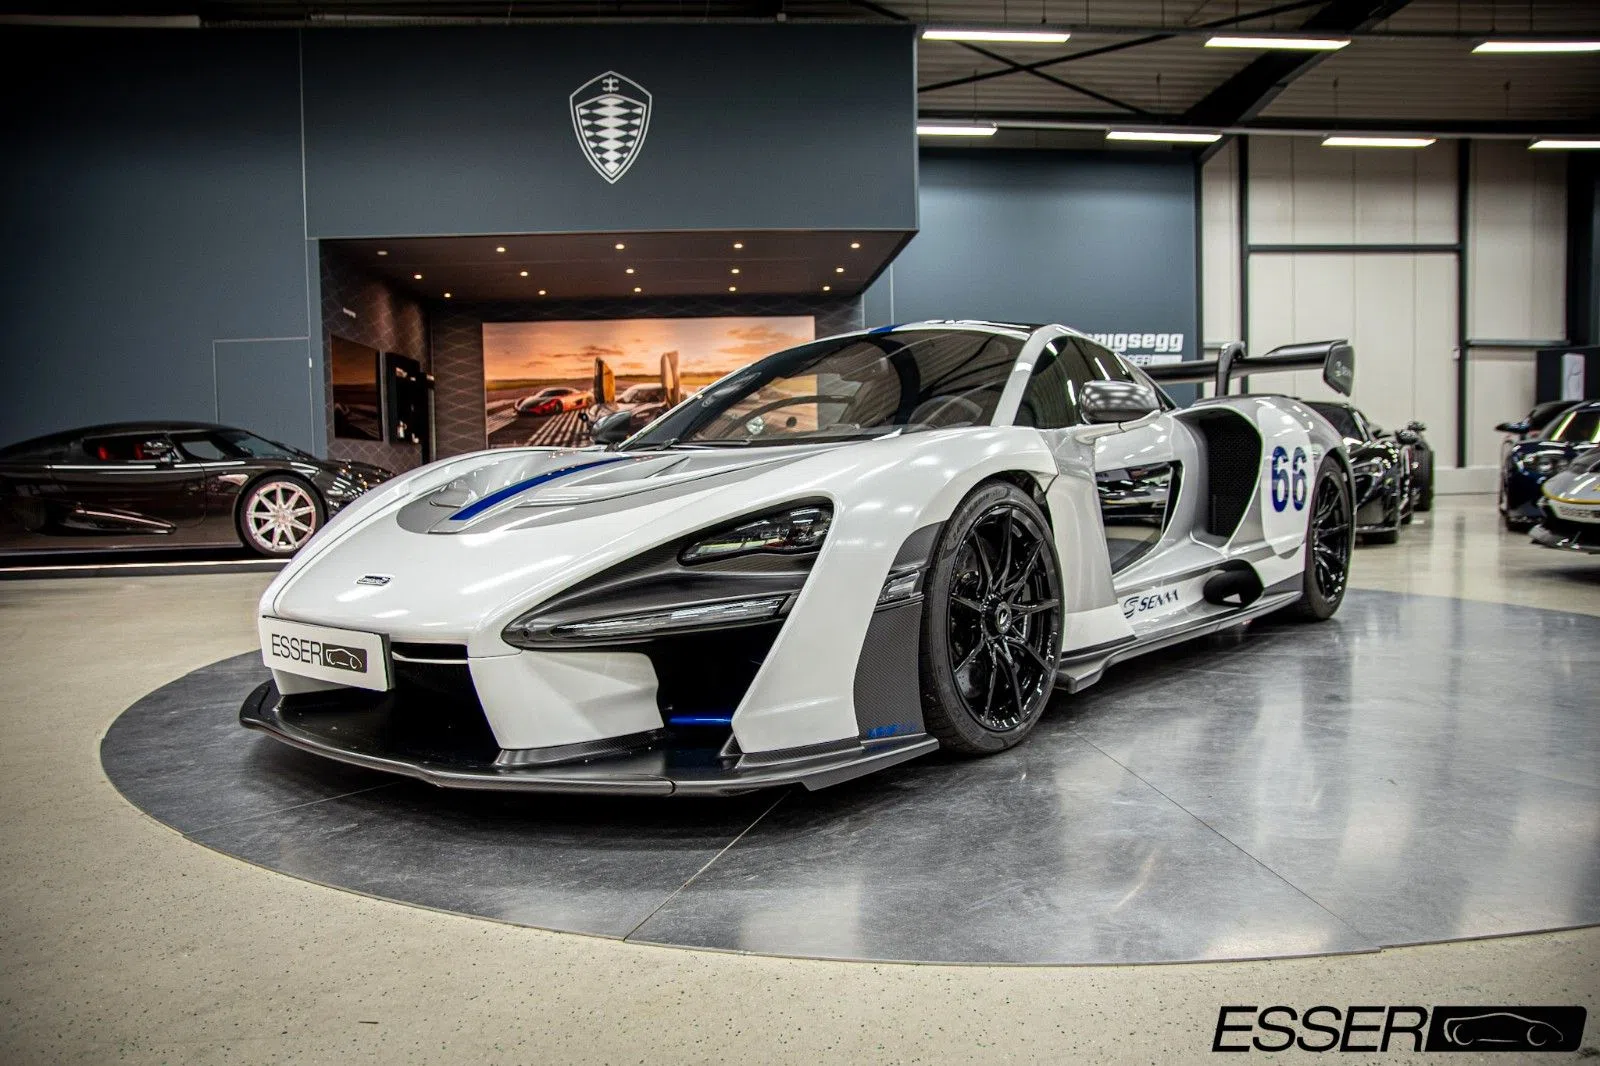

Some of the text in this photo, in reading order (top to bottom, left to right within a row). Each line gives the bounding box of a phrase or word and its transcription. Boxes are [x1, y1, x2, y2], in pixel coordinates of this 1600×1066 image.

[1087, 333, 1184, 352] nigsegg
[1271, 446, 1307, 512] 66
[271, 633, 322, 666] ESSER
